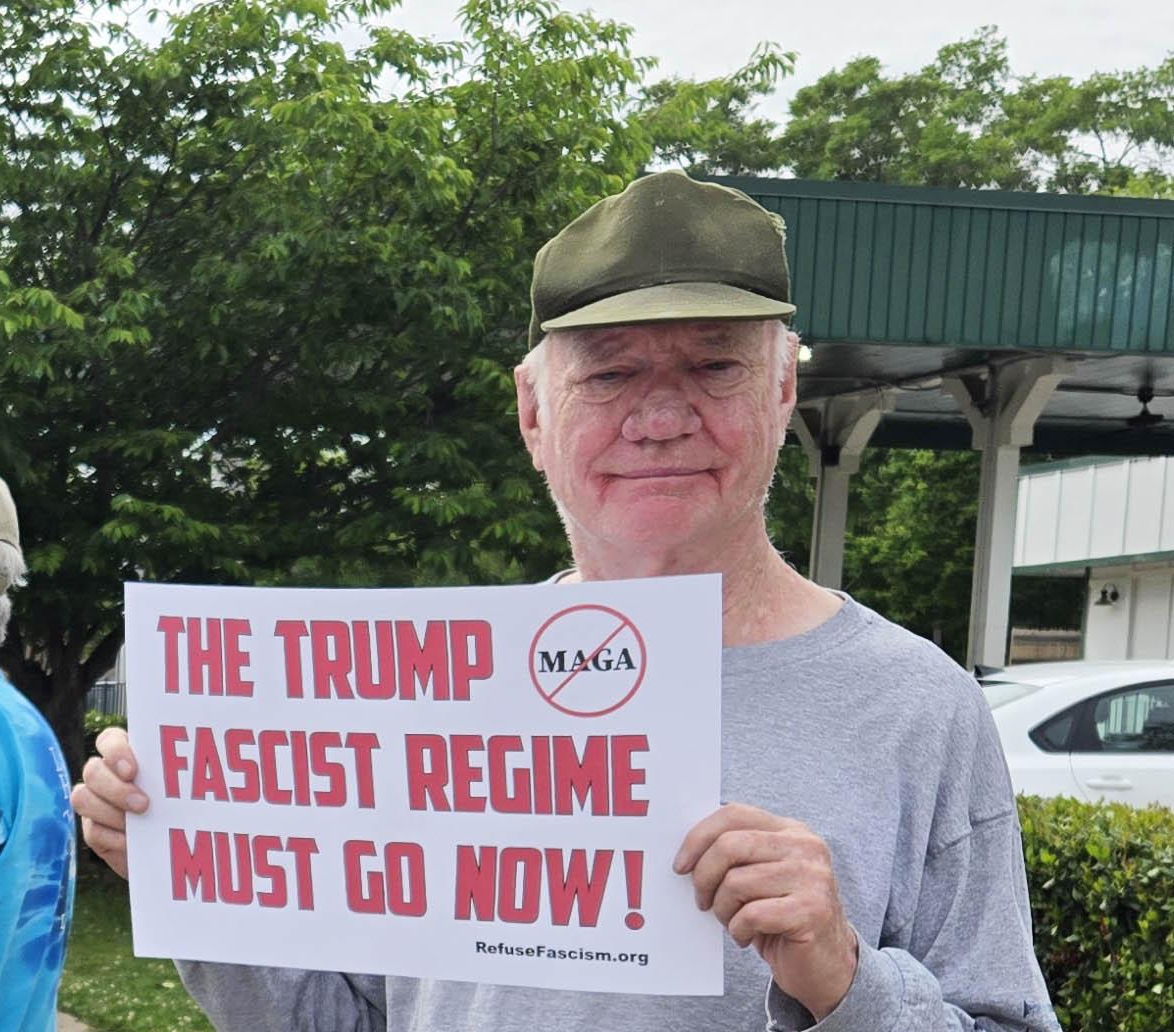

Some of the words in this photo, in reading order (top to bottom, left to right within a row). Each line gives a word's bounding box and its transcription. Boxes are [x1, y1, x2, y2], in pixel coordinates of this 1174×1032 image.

[156, 616, 254, 697] THE
[274, 619, 494, 701] TRUMP
[538, 648, 637, 673] MAGA
[159, 724, 381, 809] FASCIST
[404, 733, 650, 817] REGIME
[168, 828, 320, 912] MUST
[342, 839, 428, 917] GO
[453, 844, 646, 931] NOW!
[475, 941, 650, 966] RefuseFascism.org
